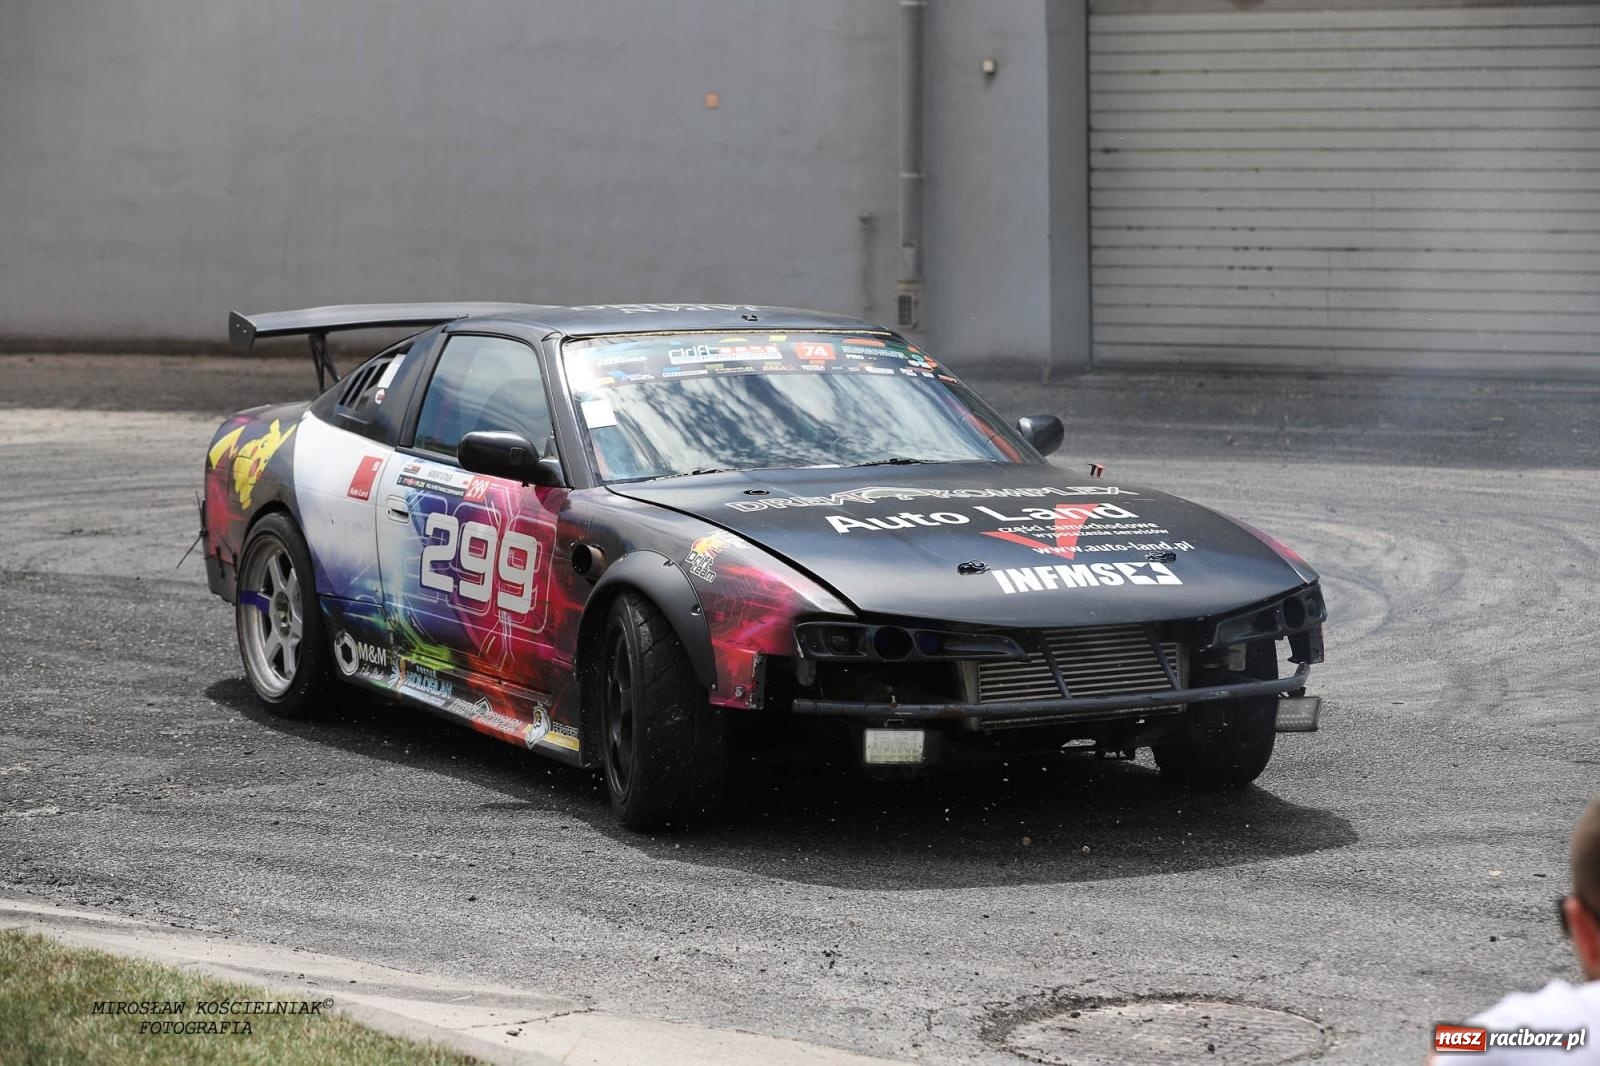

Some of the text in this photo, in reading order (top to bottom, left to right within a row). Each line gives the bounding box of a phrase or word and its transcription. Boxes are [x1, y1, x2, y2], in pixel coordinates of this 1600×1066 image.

[804, 345, 828, 357] 74
[825, 502, 1140, 534] Auto Land
[1046, 522, 1159, 532] samochodowe
[1033, 540, 1196, 555] www.auto-land.pl
[421, 512, 538, 614] 299
[990, 562, 1126, 594] INFMS
[358, 642, 387, 667] M&M
